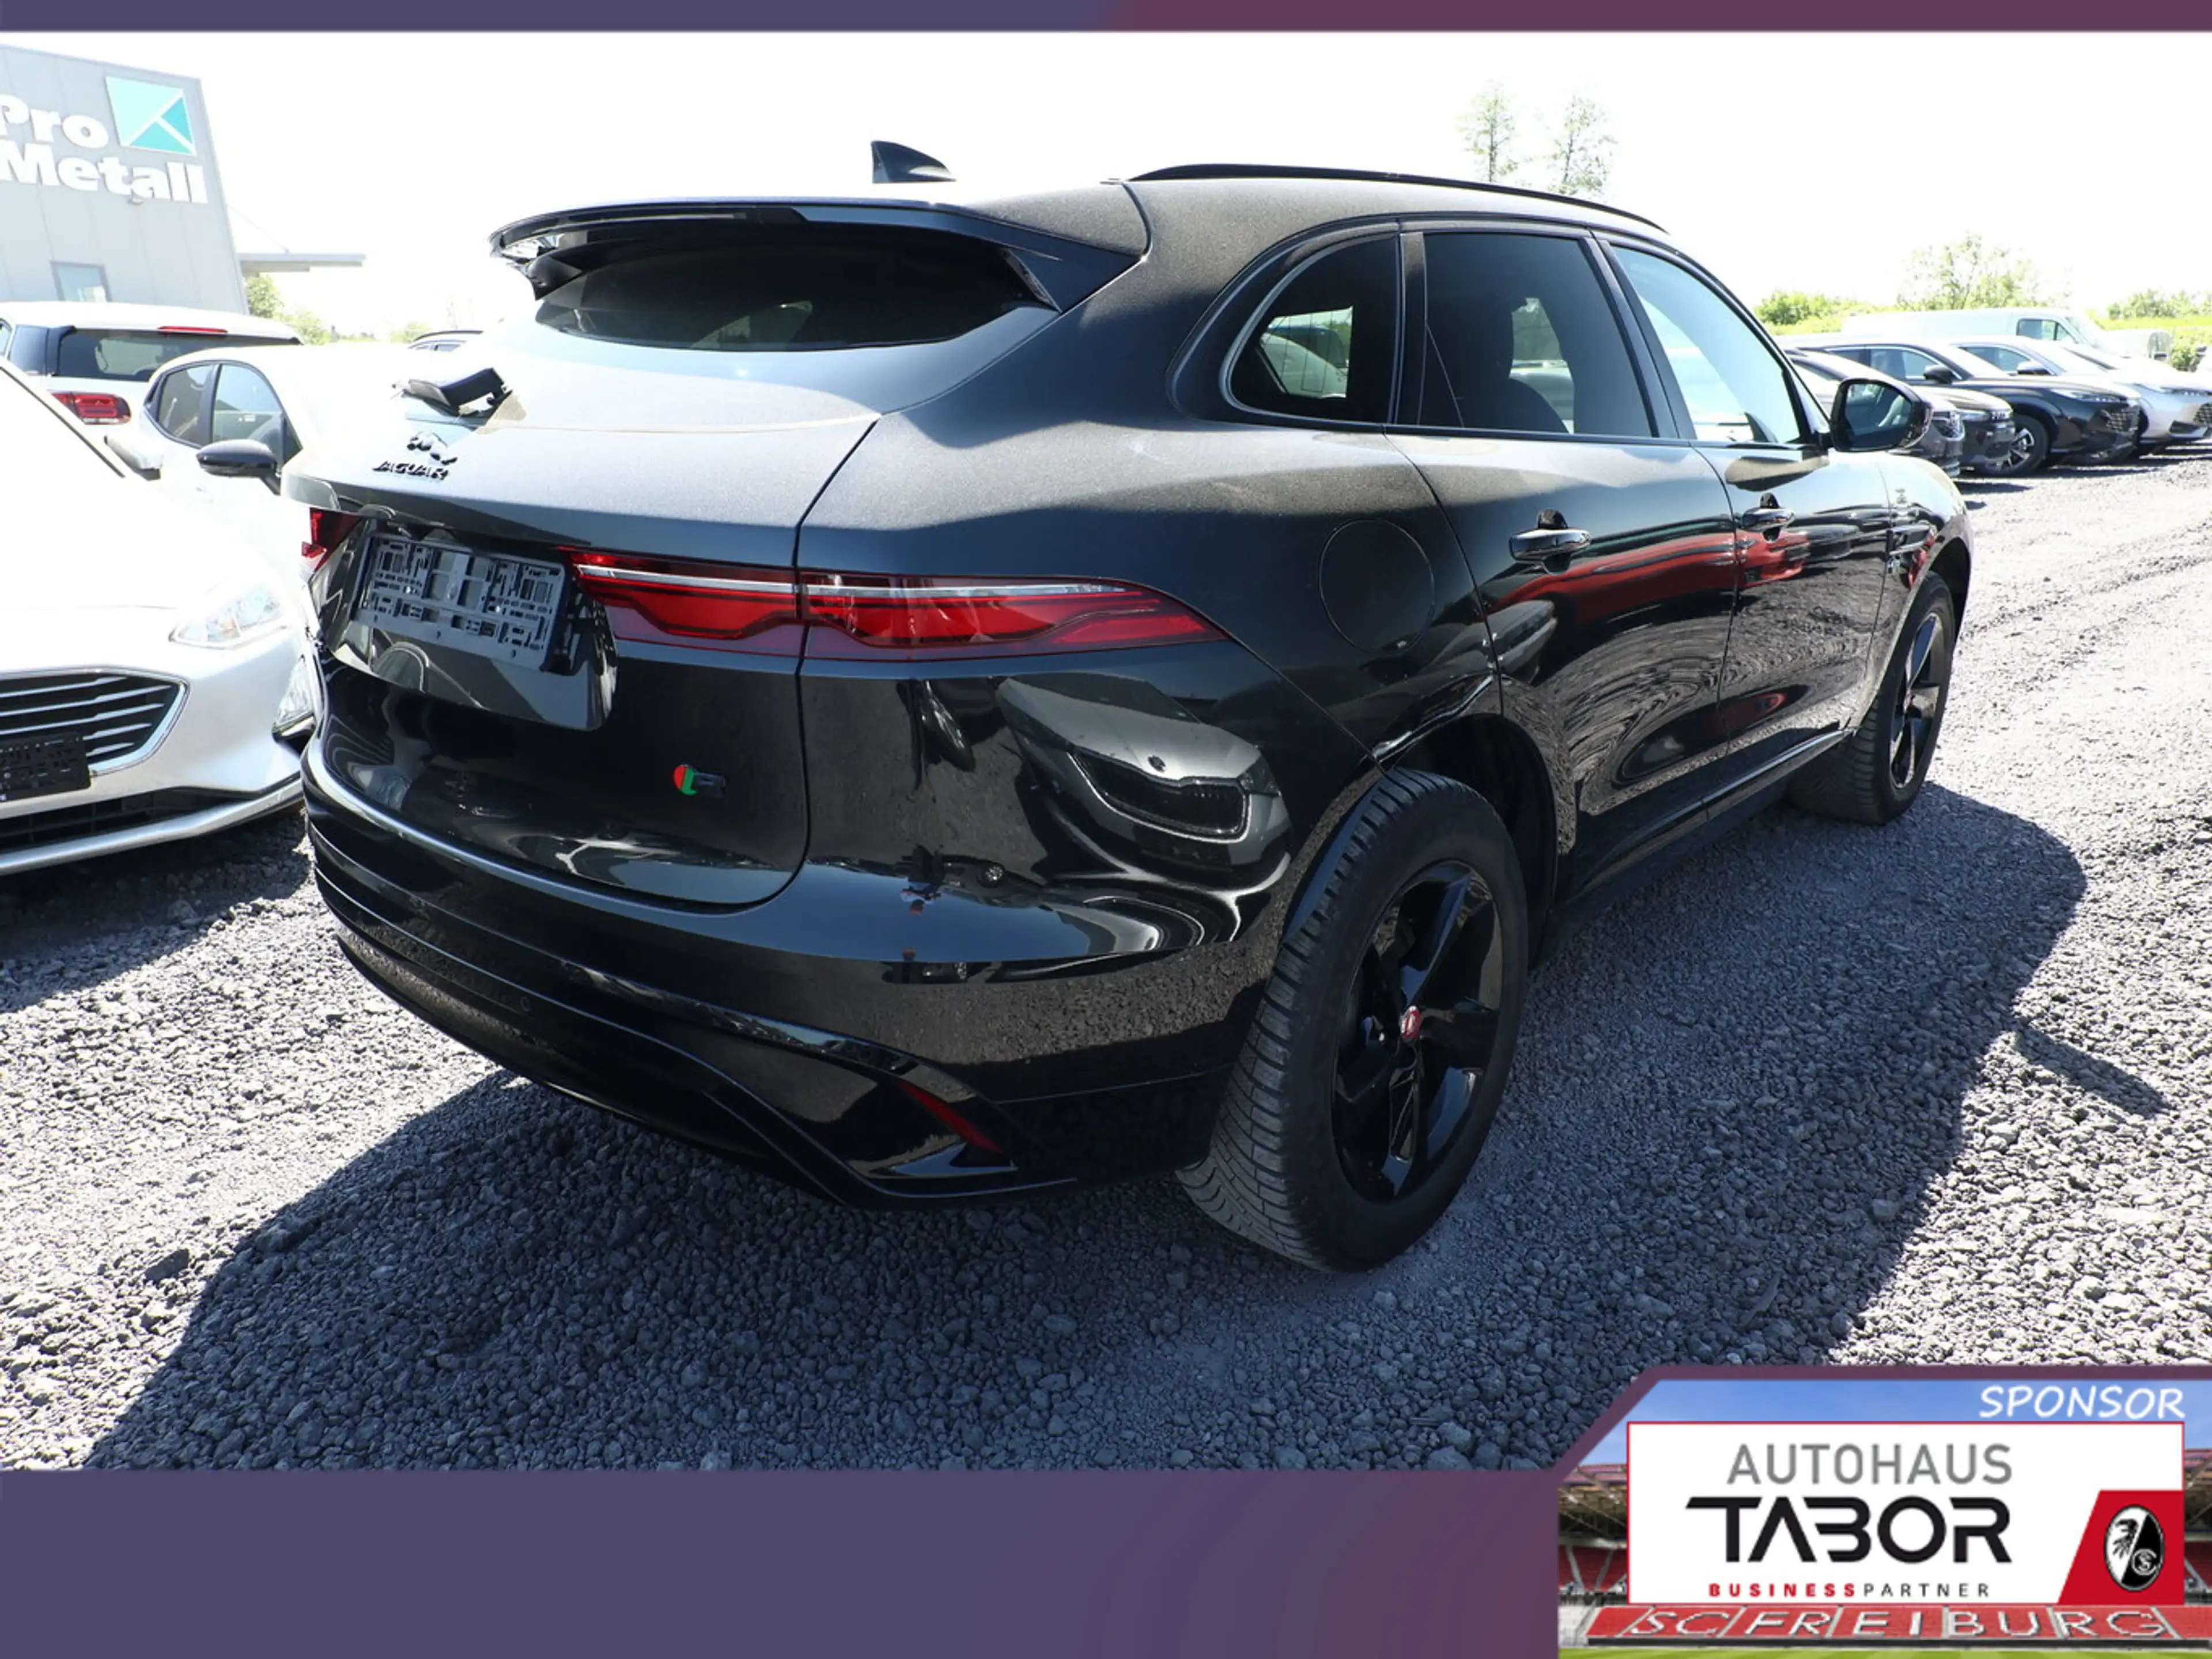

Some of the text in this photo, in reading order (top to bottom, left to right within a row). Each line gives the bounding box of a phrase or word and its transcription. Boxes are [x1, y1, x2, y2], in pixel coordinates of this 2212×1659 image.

[0, 94, 109, 149] Pro
[0, 140, 209, 204] Metall
[372, 460, 449, 480] JAGUAR
